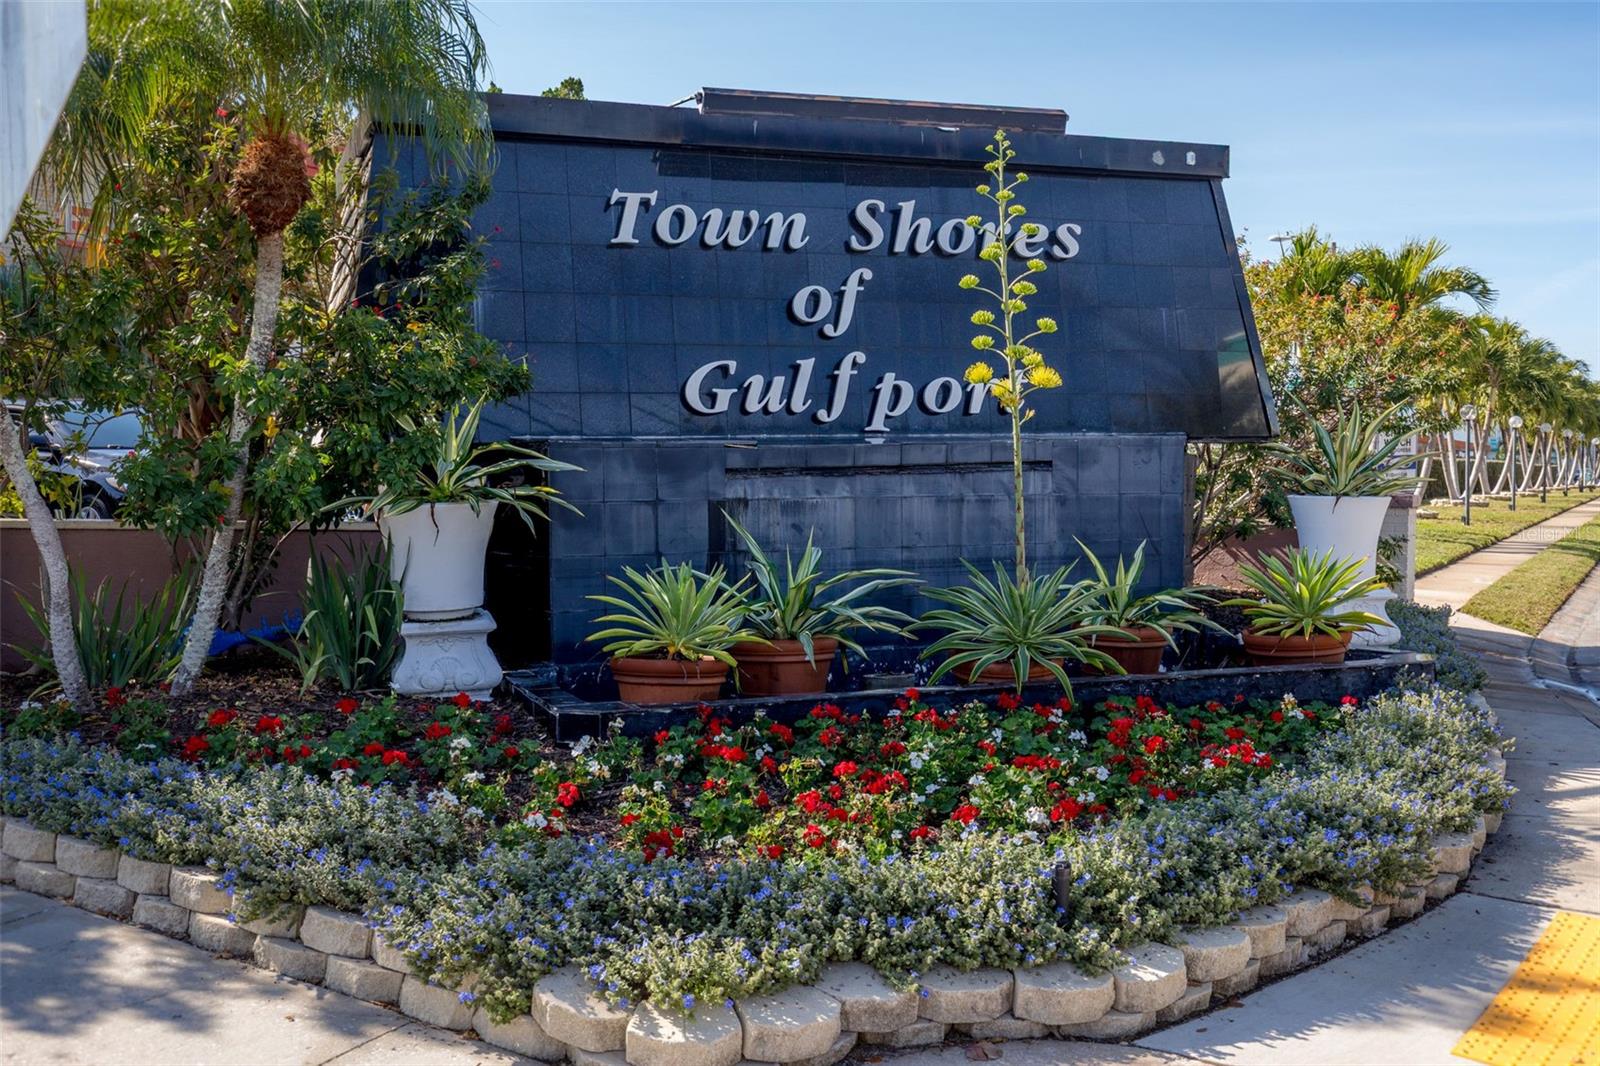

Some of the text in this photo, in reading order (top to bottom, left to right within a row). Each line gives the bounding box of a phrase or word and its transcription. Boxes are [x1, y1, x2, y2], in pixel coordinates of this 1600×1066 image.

[609, 187, 1082, 259] Town Shores
[791, 267, 873, 338] of
